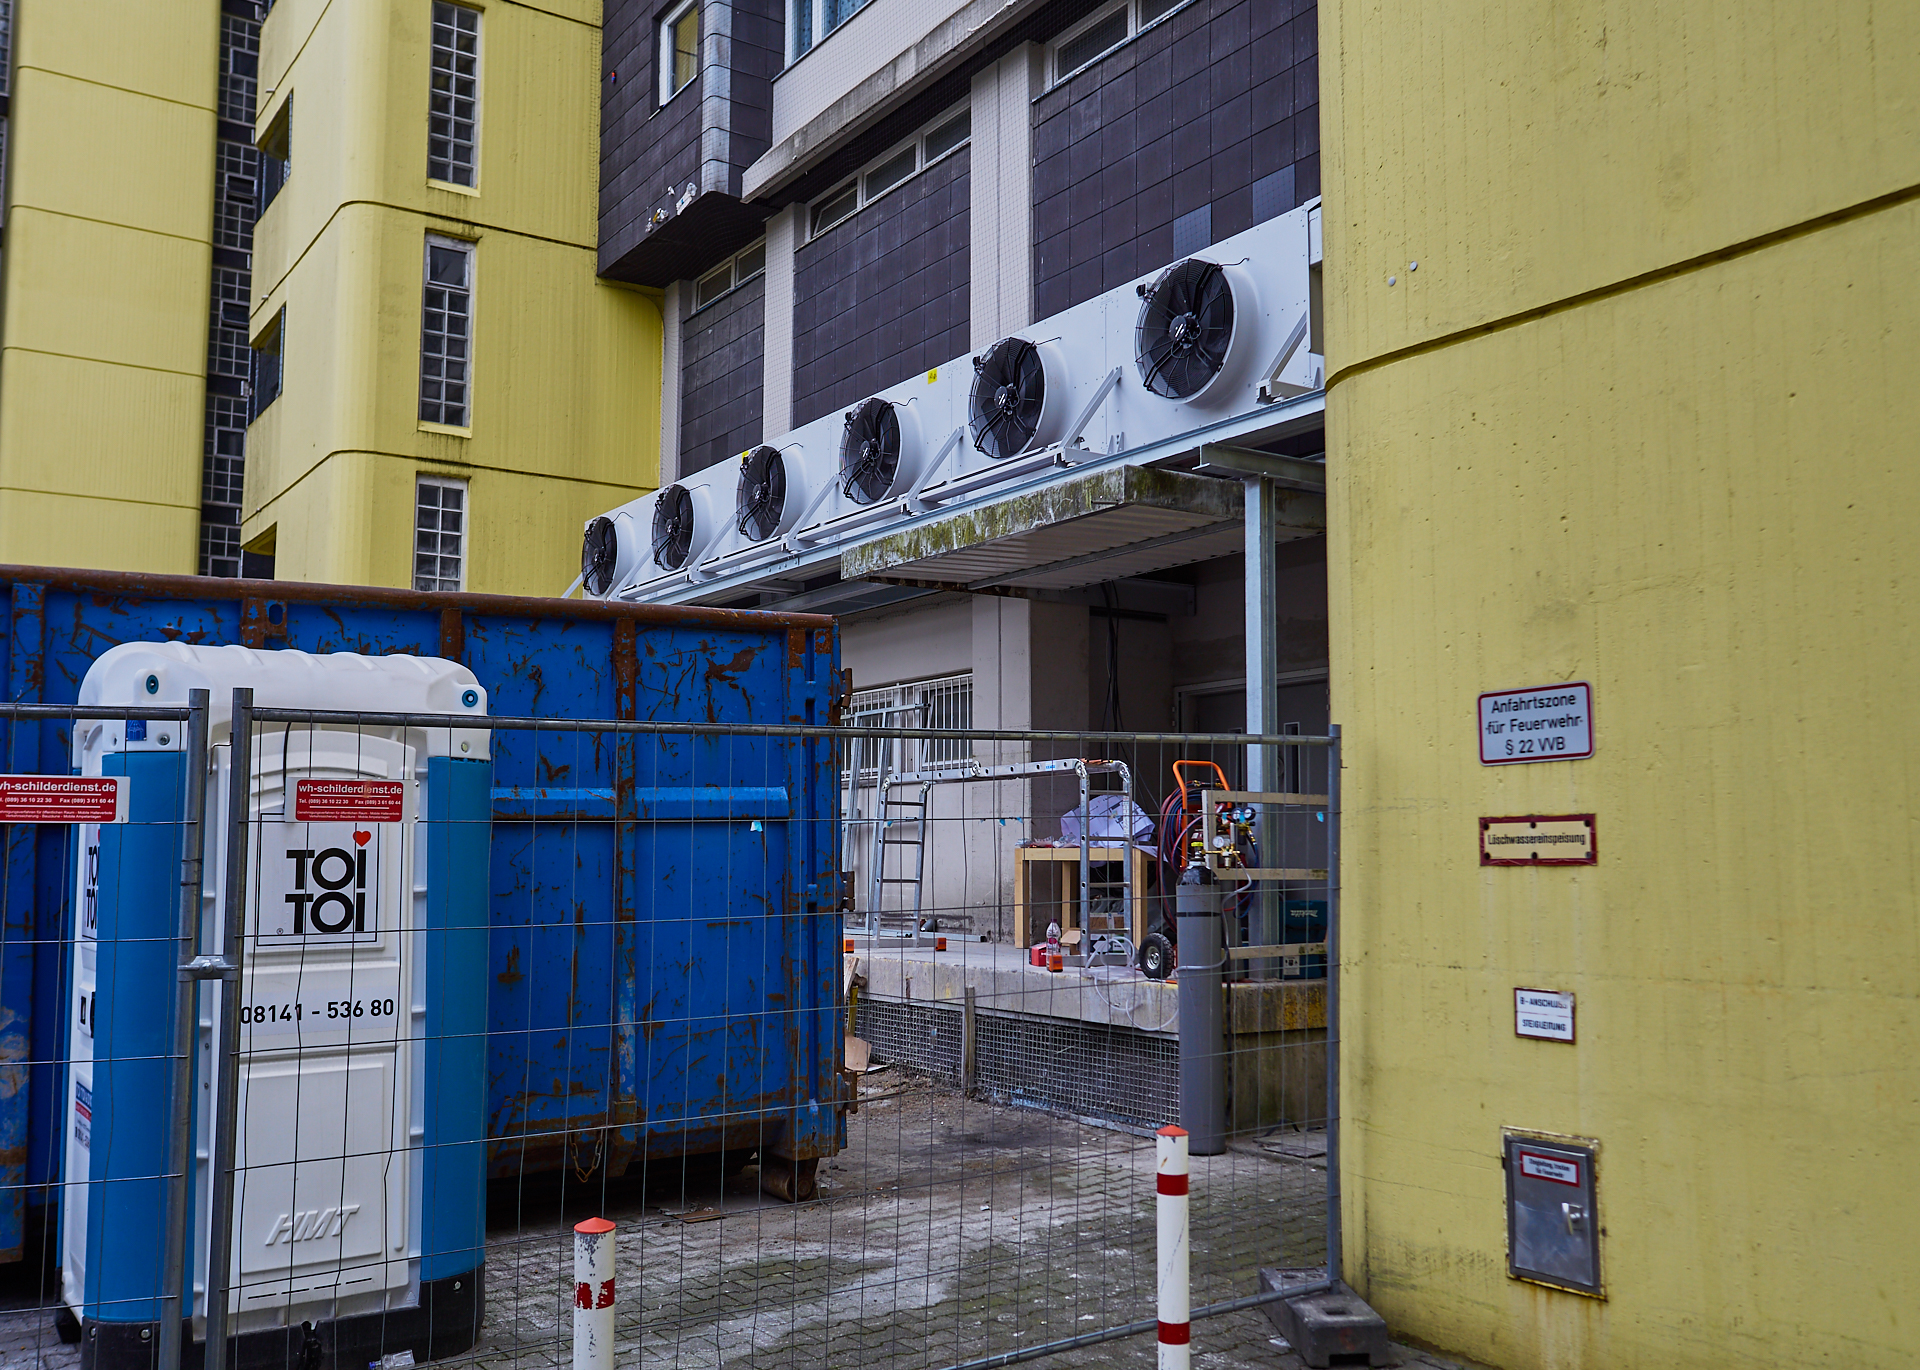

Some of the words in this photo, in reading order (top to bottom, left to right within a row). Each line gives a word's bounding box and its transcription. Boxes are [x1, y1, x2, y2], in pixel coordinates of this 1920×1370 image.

[1491, 694, 1576, 713] Anfahrtszone
[1487, 721, 1506, 734] für
[1510, 714, 1581, 732] Feuerwehr
[1505, 739, 1514, 756] §
[1519, 739, 1534, 754] 22
[1538, 736, 1566, 752] VVB
[298, 783, 402, 795] wh-schilderdienst.de
[1487, 832, 1586, 845] Löschwassereinspeisung
[285, 891, 365, 934] TOI
[240, 1004, 302, 1024] 08141
[327, 1000, 364, 1019] 536
[370, 998, 394, 1017] 80
[1522, 1019, 1567, 1032] STEIGLEITUNG
[264, 1204, 360, 1247] HMT
